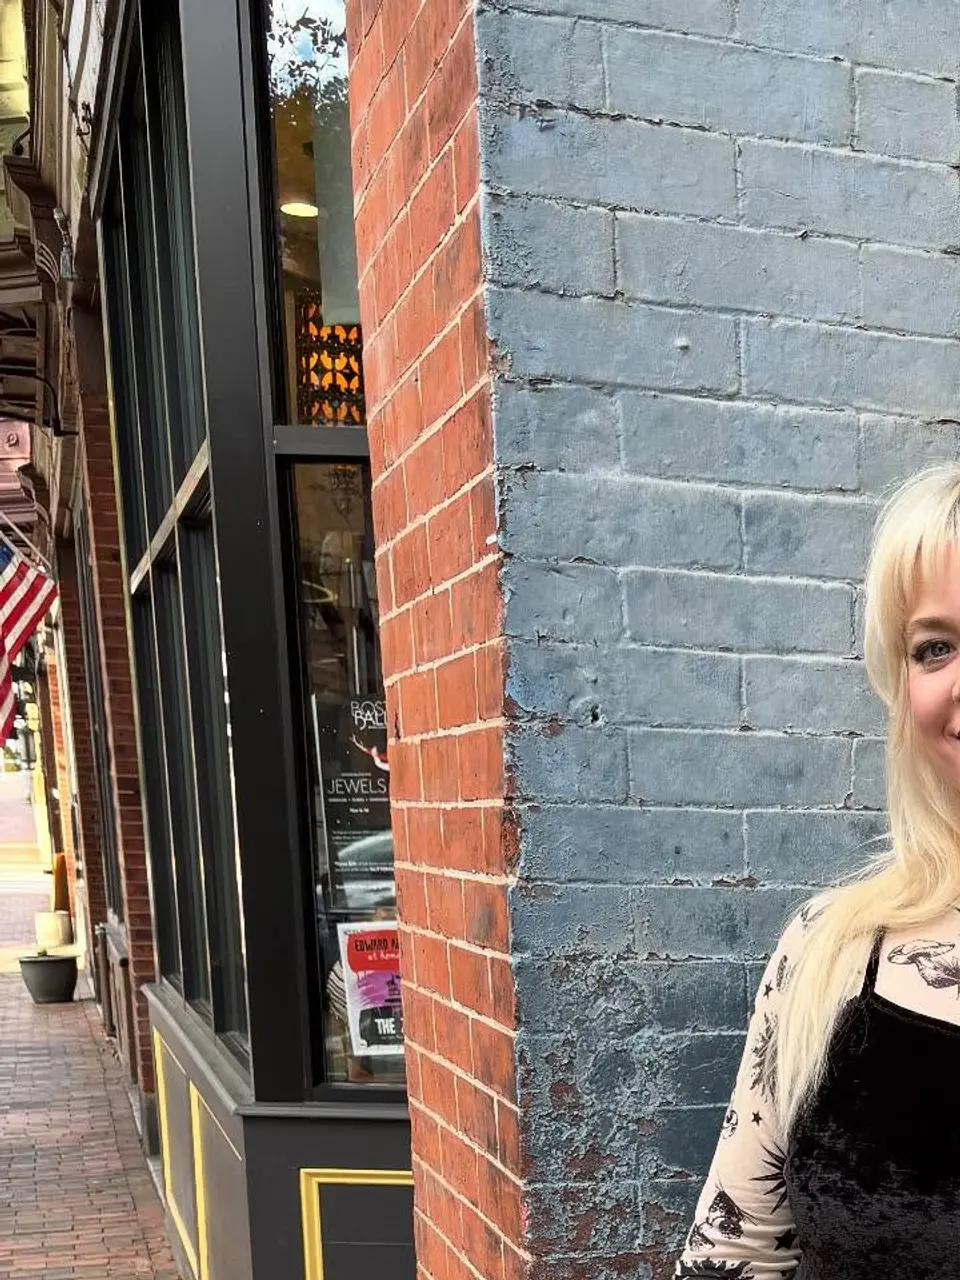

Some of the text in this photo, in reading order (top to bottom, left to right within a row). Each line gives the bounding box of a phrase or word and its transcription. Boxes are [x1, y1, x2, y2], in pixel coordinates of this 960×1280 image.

[351, 701, 387, 717] BOS
[327, 778, 387, 794] JEWELS
[355, 939, 388, 951] EDWARD
[374, 1017, 396, 1035] THE
